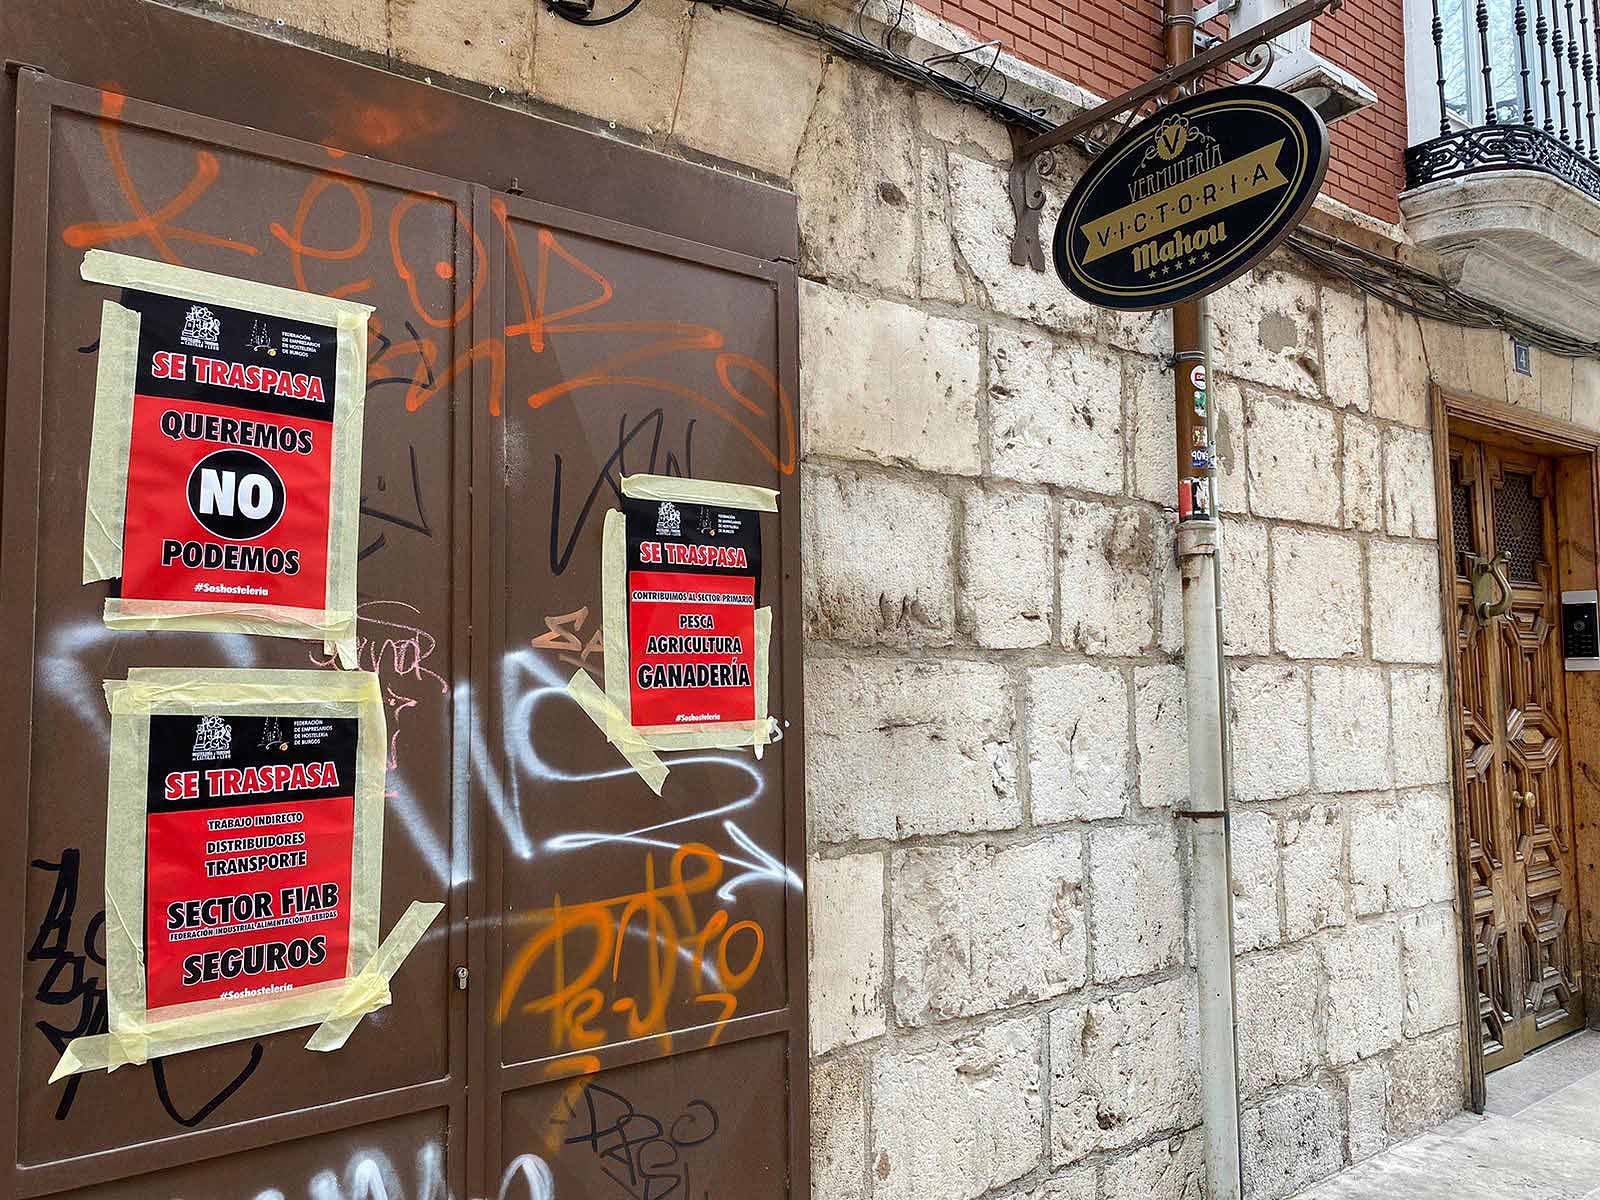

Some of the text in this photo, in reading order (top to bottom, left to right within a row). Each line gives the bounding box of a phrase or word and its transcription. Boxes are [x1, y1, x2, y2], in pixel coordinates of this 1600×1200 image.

[1163, 131, 1180, 154] V
[1127, 143, 1223, 202] VERMUTERÍA
[1131, 221, 1228, 272] Mahou
[1519, 350, 1526, 368] 4
[152, 351, 186, 380] SE
[192, 356, 325, 403] TRASPASA
[160, 410, 313, 455] QUEREMOS
[200, 467, 274, 520] NO
[162, 539, 301, 576] PODEMOS
[640, 541, 748, 569] SE TRASPASA
[632, 591, 753, 604] CONTRIBUIMOS AL SECTOR PRIMARIO
[679, 614, 714, 630] PESCA
[646, 636, 743, 654] AGRICULTURA
[637, 657, 751, 690] GANADERÍA
[165, 761, 340, 800] SE TRASPASA
[208, 812, 304, 831] TRABAJO INDIRECTO
[206, 832, 305, 854] DISTRIBUIDORES
[205, 851, 307, 877] TRANSPORTE
[167, 883, 339, 930] SECTOR FIAB
[169, 928, 214, 942] FEDERACIÓN
[215, 923, 255, 936] INDUSTRIAL
[256, 916, 304, 930] ALIMENTACIÓN
[311, 910, 337, 922] BEBIDAS
[182, 935, 327, 986] SEGUROS
